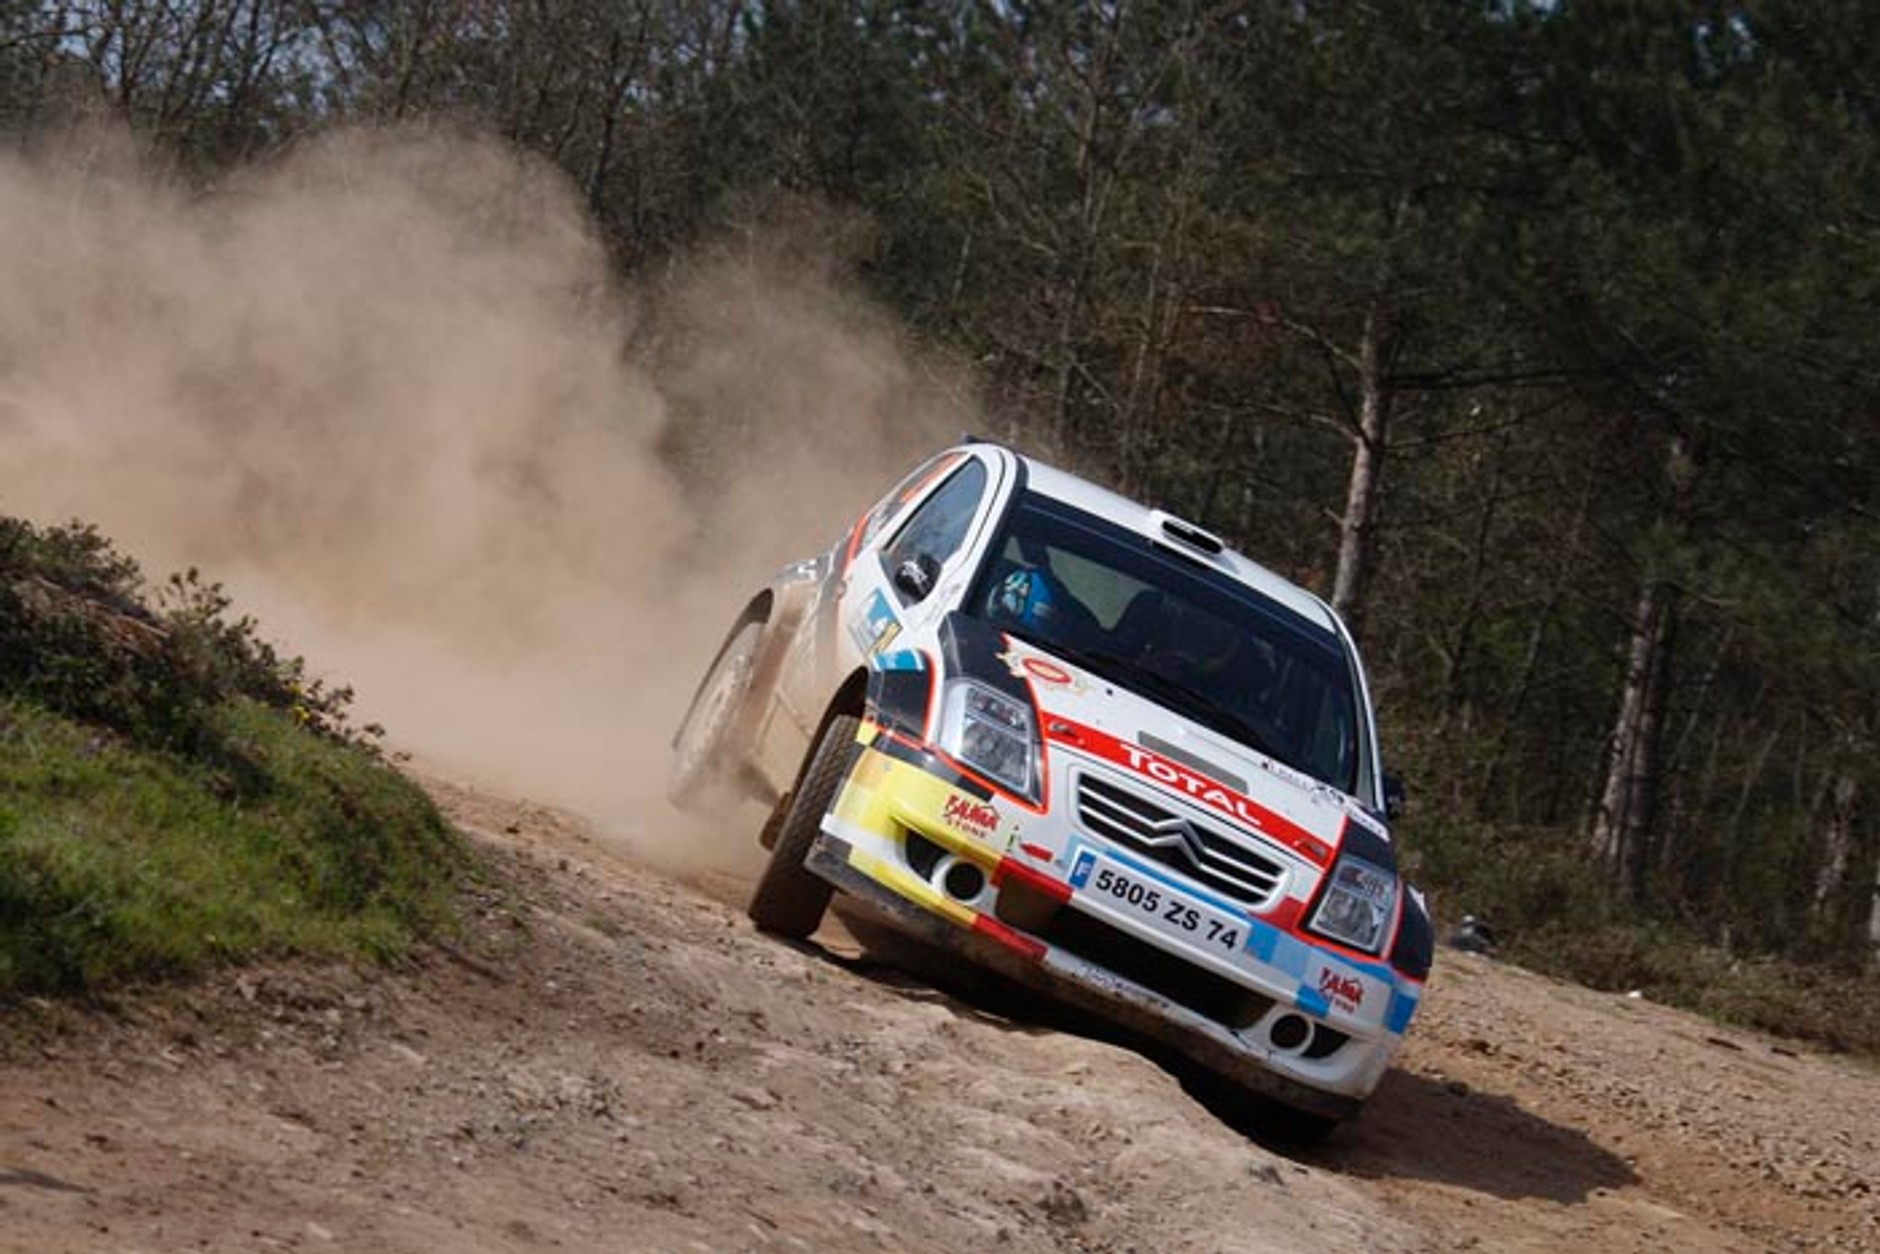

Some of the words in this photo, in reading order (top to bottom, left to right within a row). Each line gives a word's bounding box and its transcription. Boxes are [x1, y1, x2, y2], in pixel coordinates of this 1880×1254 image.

[1120, 743, 1262, 826] TOTAL
[1096, 869, 1161, 912] 5805
[1163, 902, 1200, 931] ZS
[1206, 920, 1238, 950] 74
